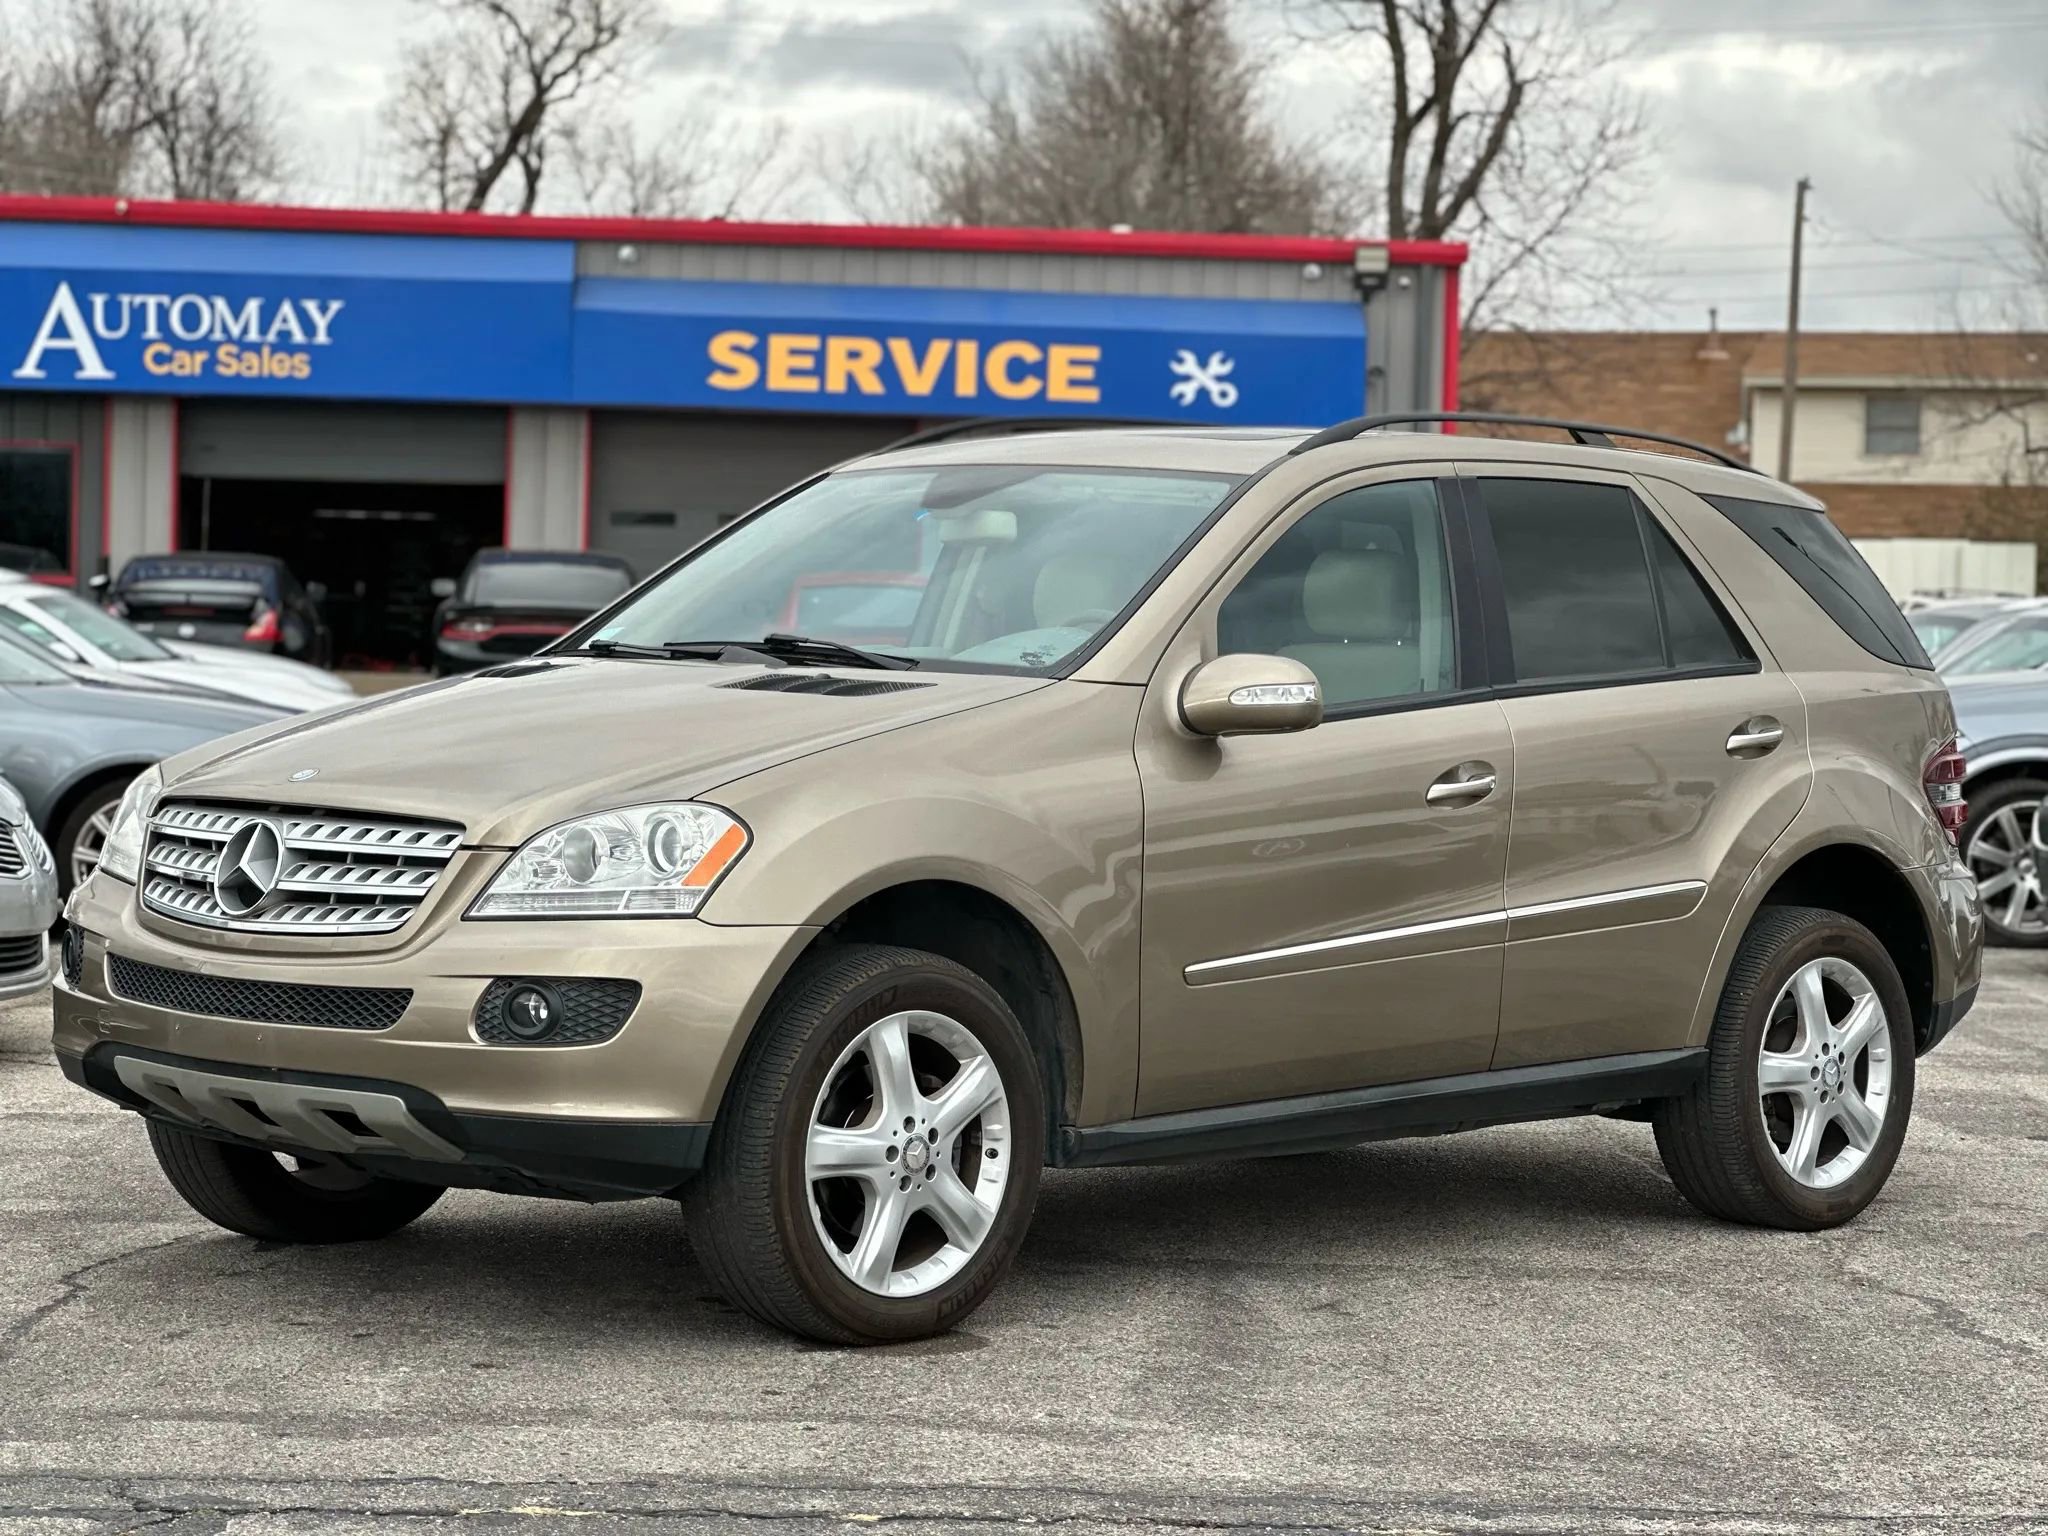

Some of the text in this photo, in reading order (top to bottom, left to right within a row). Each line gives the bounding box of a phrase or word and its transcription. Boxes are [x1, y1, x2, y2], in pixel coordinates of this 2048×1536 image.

[13, 281, 346, 379] AUTOMAY
[143, 343, 311, 378] Car Sales
[706, 330, 1101, 402] SERVICE
